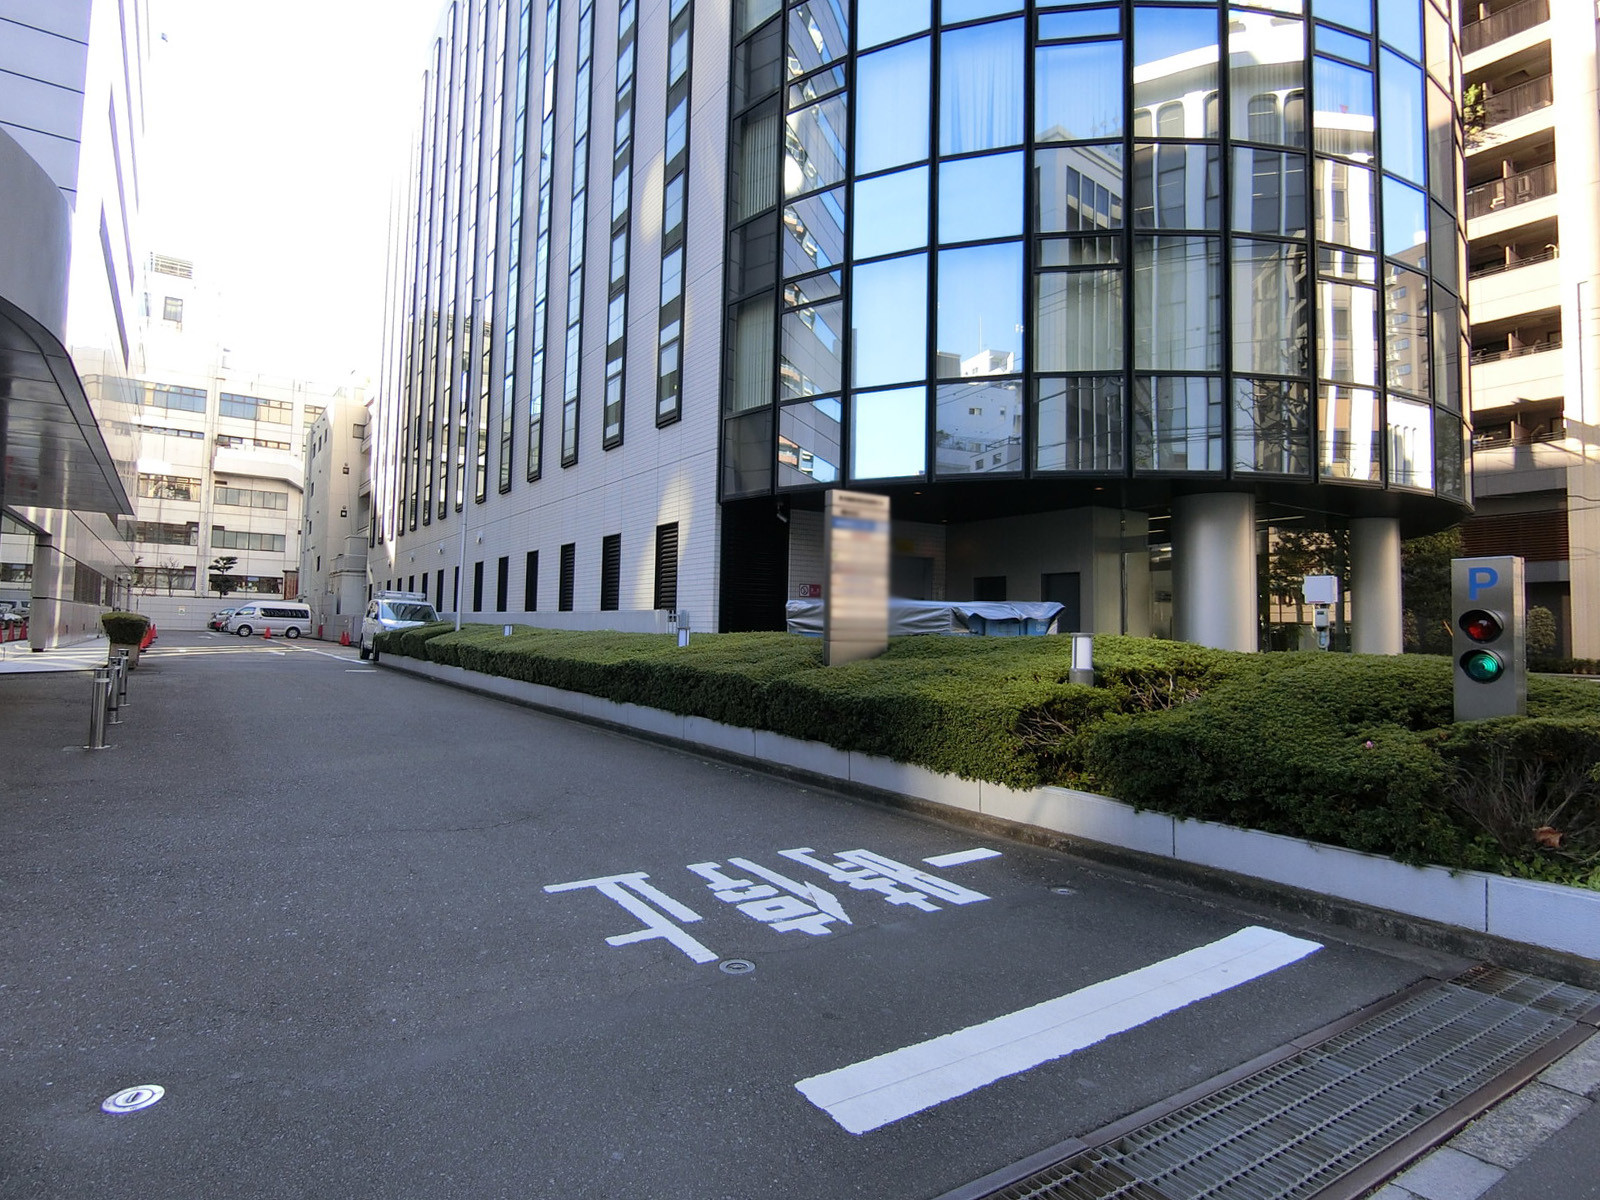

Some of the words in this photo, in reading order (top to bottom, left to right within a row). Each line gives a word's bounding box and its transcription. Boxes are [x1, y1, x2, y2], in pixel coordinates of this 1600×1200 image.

[1468, 567, 1498, 600] P
[543, 847, 1003, 964] 一時停止
